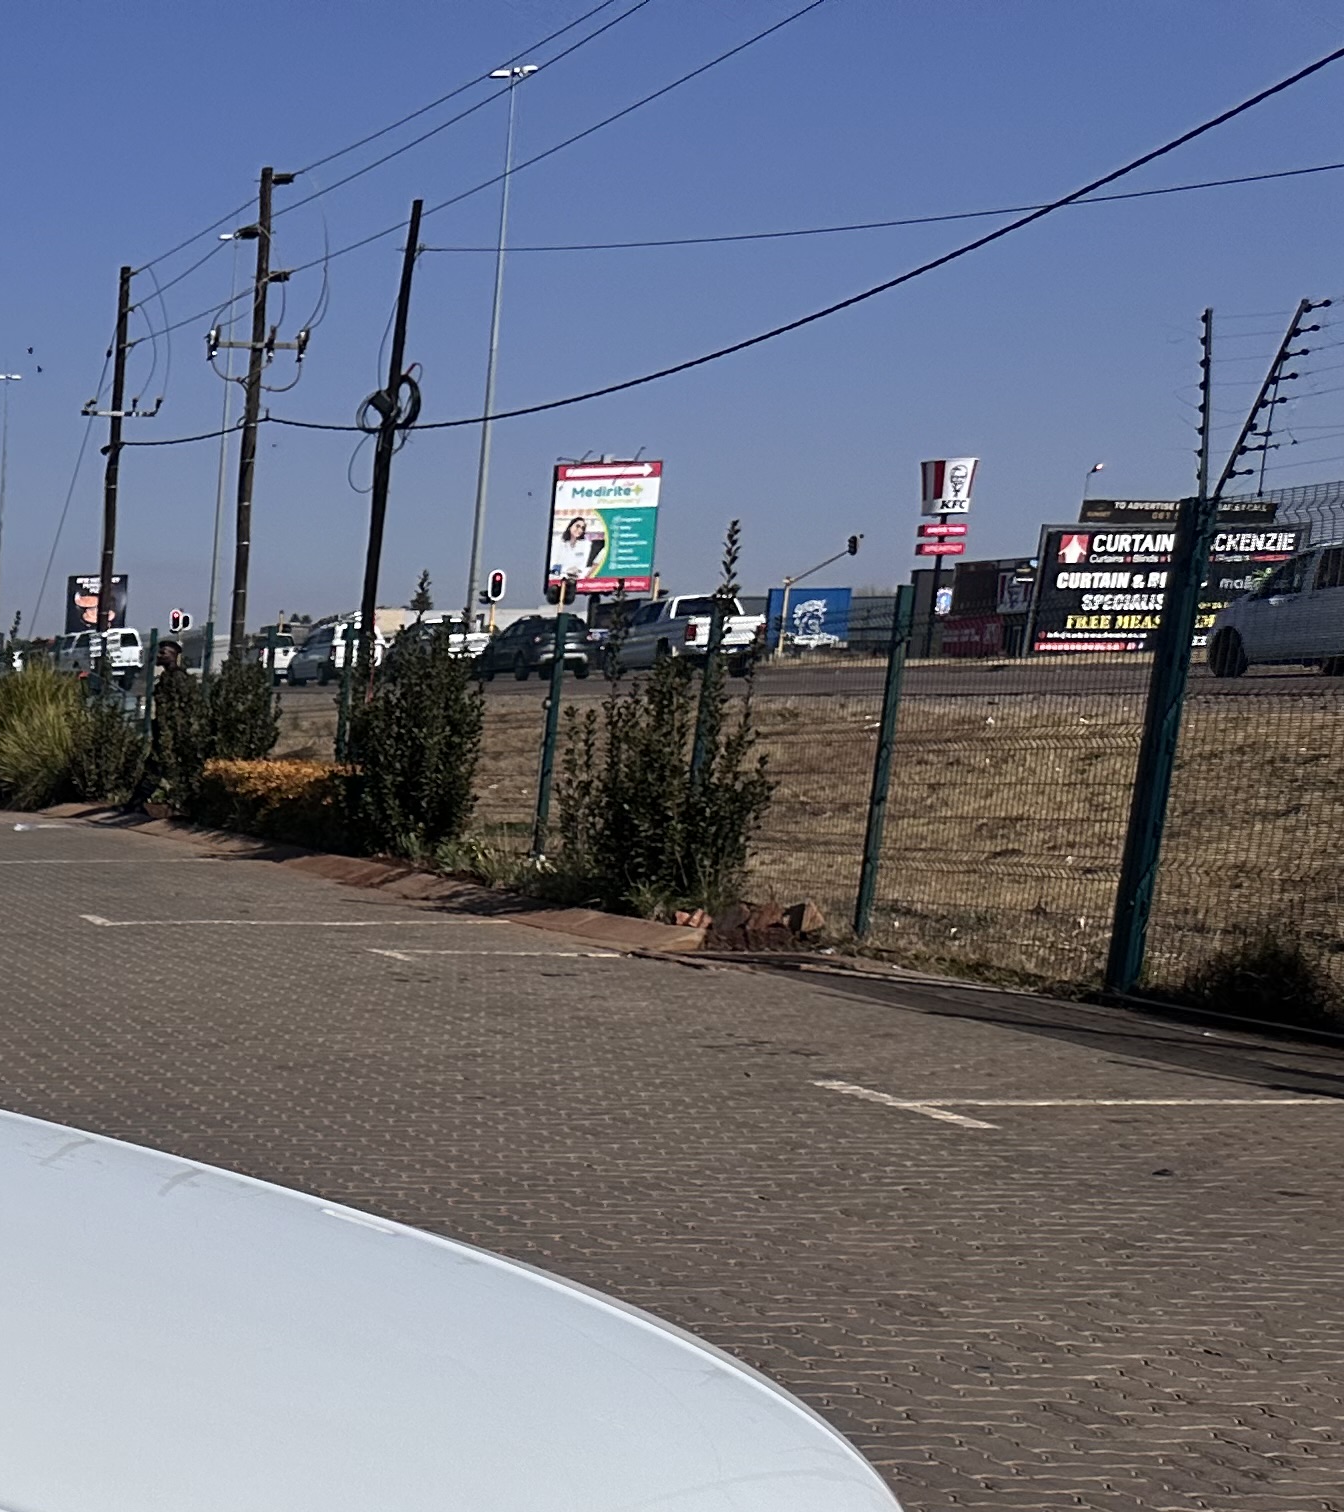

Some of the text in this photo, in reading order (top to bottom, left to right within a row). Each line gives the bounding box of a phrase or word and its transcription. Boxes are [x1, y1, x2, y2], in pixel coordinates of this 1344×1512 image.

[940, 500, 966, 510] KFC
[1114, 501, 1126, 510] TO
[1127, 502, 1175, 511] ADVERTISE
[1092, 533, 1295, 552] CURTAIN CKENZIE
[1089, 555, 1124, 563] Curtains
[1132, 554, 1158, 563] Blinds
[1056, 572, 1130, 589] CURTAIN
[1131, 574, 1145, 588] &
[1066, 615, 1110, 629] FREE
